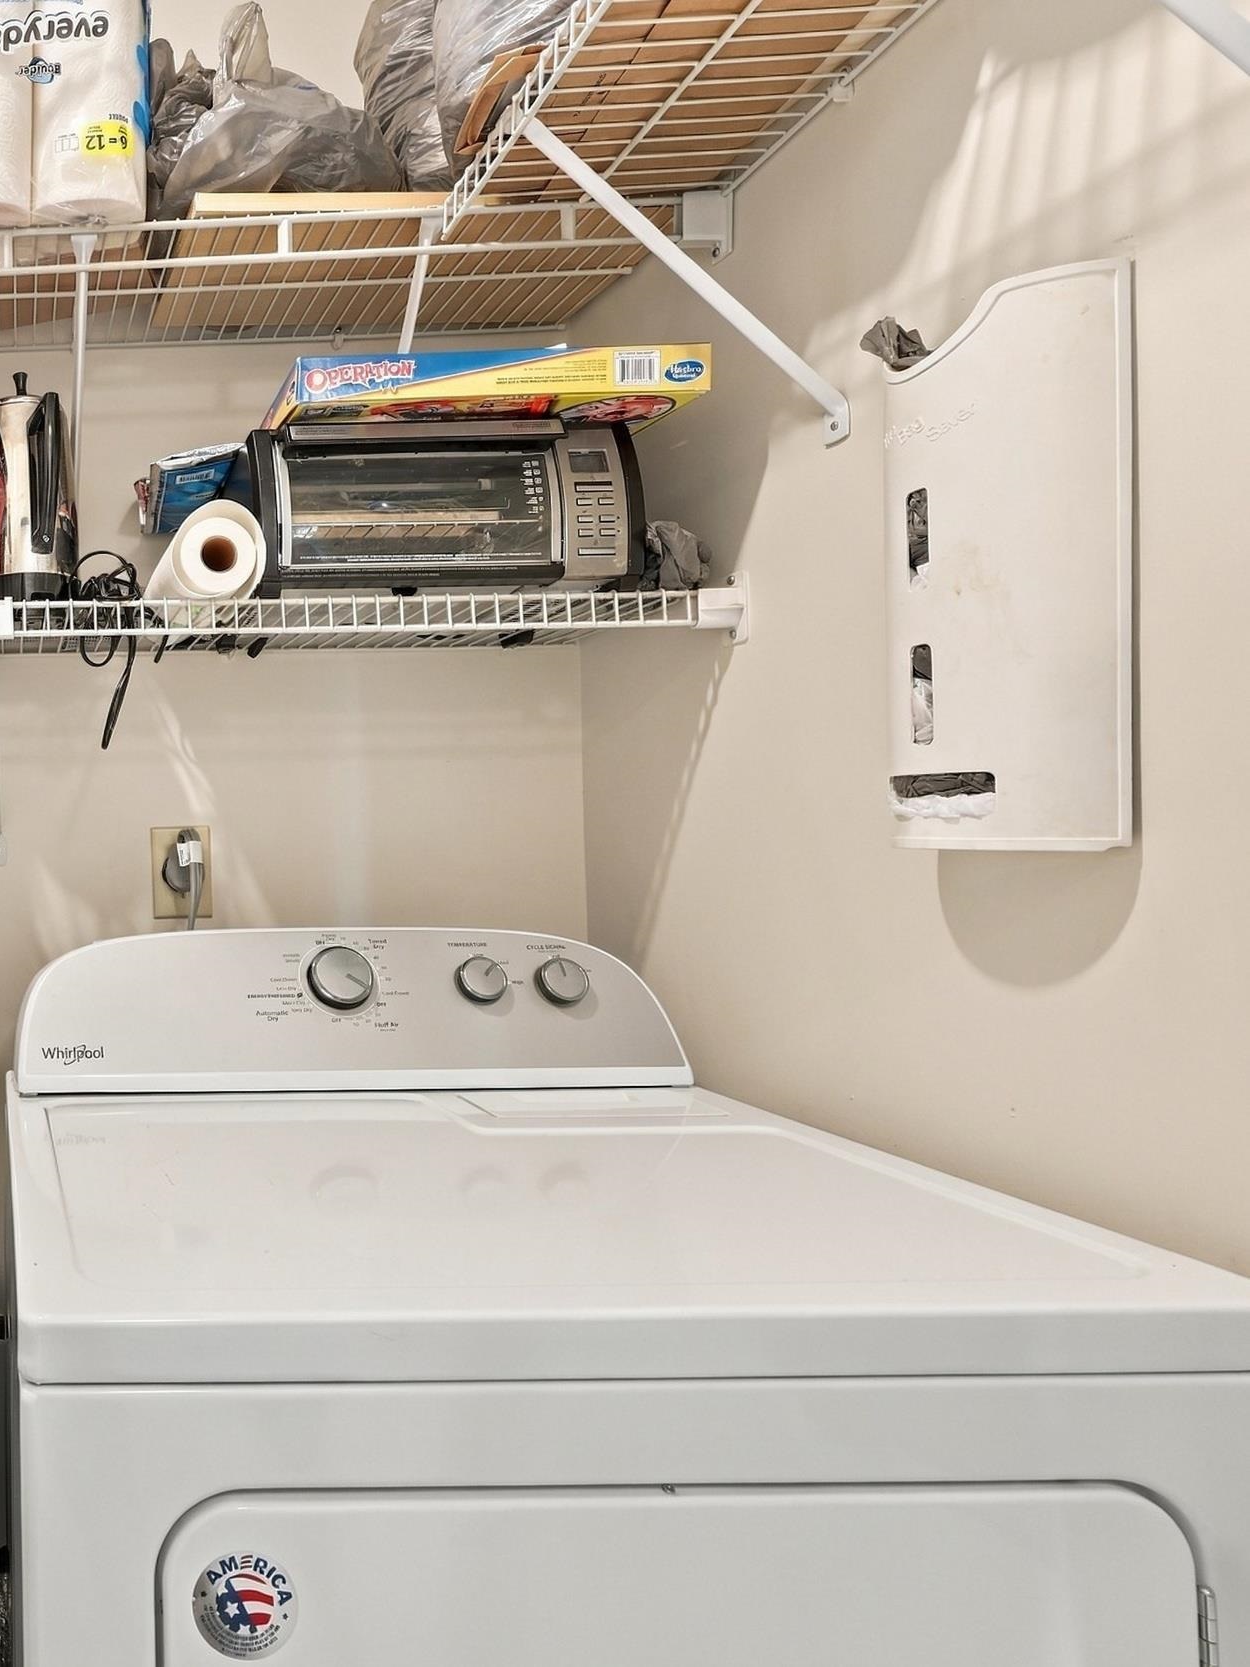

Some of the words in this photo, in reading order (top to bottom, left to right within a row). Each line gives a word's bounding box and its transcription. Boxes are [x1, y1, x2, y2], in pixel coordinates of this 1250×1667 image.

[18, 63, 61, 77] Boulder
[85, 134, 105, 150] 12
[119, 135, 128, 149] 6
[670, 363, 702, 374] Hasbro
[305, 360, 416, 394] OPERATION
[41, 1044, 104, 1065] Whirlpool
[206, 1554, 293, 1606] AMERICA
